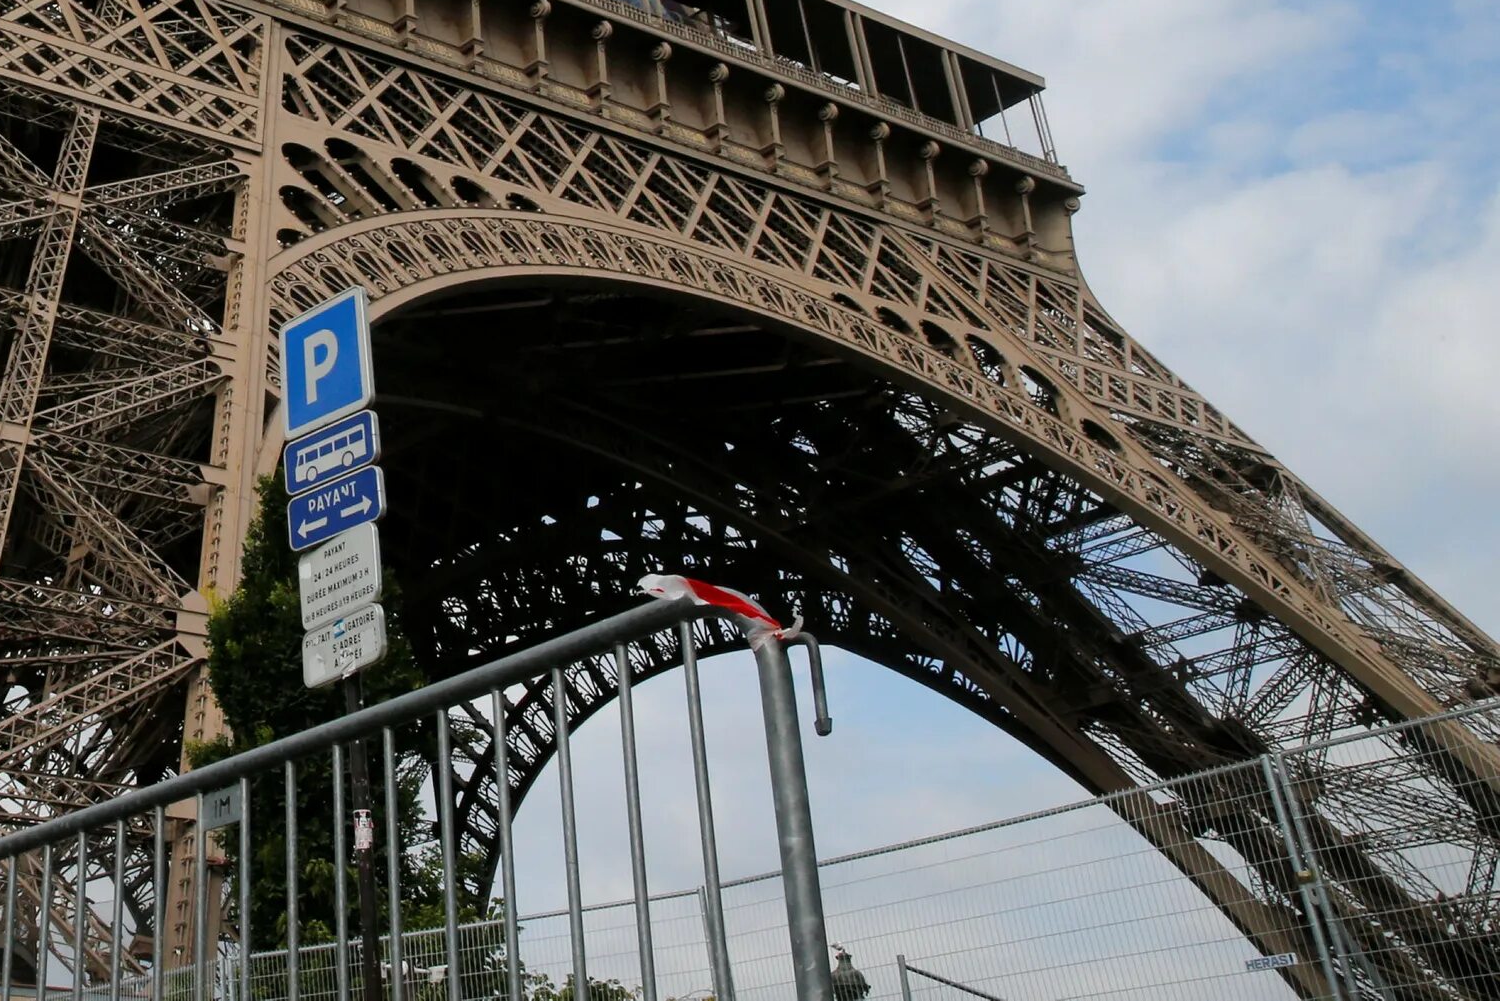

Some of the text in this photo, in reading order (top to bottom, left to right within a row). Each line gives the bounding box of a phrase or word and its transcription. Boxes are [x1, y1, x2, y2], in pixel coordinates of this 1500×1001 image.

[303, 328, 338, 406] P
[308, 481, 356, 513] PAYANT
[323, 541, 346, 559] PAYANT
[334, 553, 359, 573] HEURES
[327, 572, 358, 594] MAXIMUM
[315, 602, 338, 618] HEURES
[350, 583, 374, 602] HEURES
